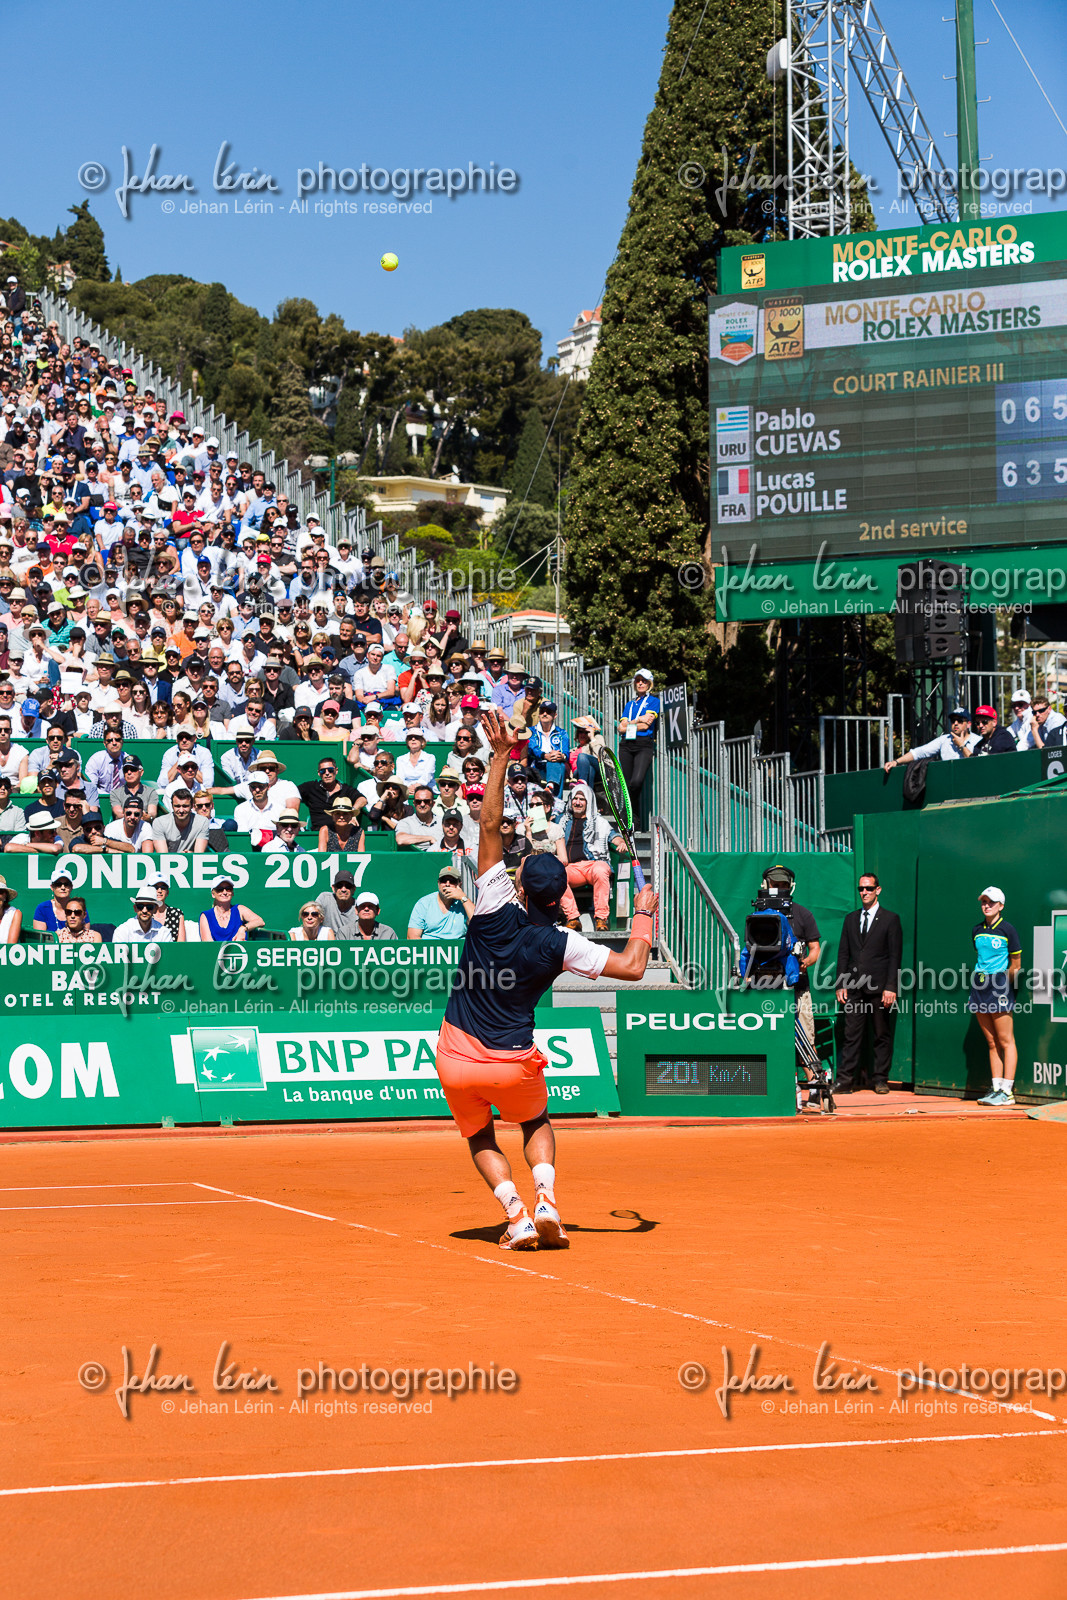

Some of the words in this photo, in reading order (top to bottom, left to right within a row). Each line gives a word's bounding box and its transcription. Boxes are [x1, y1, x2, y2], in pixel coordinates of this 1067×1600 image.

[833, 224, 1017, 263] MONTE-CARLO
[833, 255, 912, 283] ROLEX
[922, 241, 1035, 273] MASTERS
[780, 307, 800, 317] 1000
[825, 291, 985, 326] MONTE-CARLO
[863, 315, 932, 342] ROLEX
[940, 306, 1041, 335] MASTERS
[769, 341, 800, 353] ATP
[833, 372, 898, 394] COURT
[903, 365, 980, 389] RAINIER
[987, 363, 1004, 382] III
[755, 407, 815, 432] Pablo
[1002, 399, 1016, 424] 0
[1025, 397, 1041, 423] 6
[1052, 394, 1067, 420] 5
[719, 443, 746, 456] URU
[755, 430, 841, 456] CUEVAS
[757, 472, 815, 491] Lucas
[1002, 461, 1018, 487] 6
[1026, 460, 1041, 485] 3
[1054, 458, 1067, 483] 5
[721, 503, 746, 517] FRA
[757, 489, 847, 515] POUILLE
[859, 519, 895, 541] 2nd
[900, 516, 968, 538] service
[664, 686, 684, 704] LOGE
[669, 707, 682, 742] K
[1048, 751, 1062, 759] LOGES
[27, 854, 250, 889] LONDRES
[265, 853, 371, 888] 2017
[257, 947, 341, 967] SERGIO
[350, 946, 459, 965] TACCHINI
[52, 970, 99, 991] BAY
[63, 993, 73, 1006] &
[84, 992, 161, 1006] RESORT
[626, 1013, 784, 1031] PEUGEOT
[276, 1039, 369, 1074] BNP
[0, 1042, 120, 1099] OM
[657, 1061, 700, 1084] 201
[710, 1065, 751, 1082] Km/h
[1033, 1062, 1062, 1085] BNP
[282, 1089, 304, 1102] La
[309, 1086, 373, 1104] banque
[380, 1085, 425, 1099] d'un
